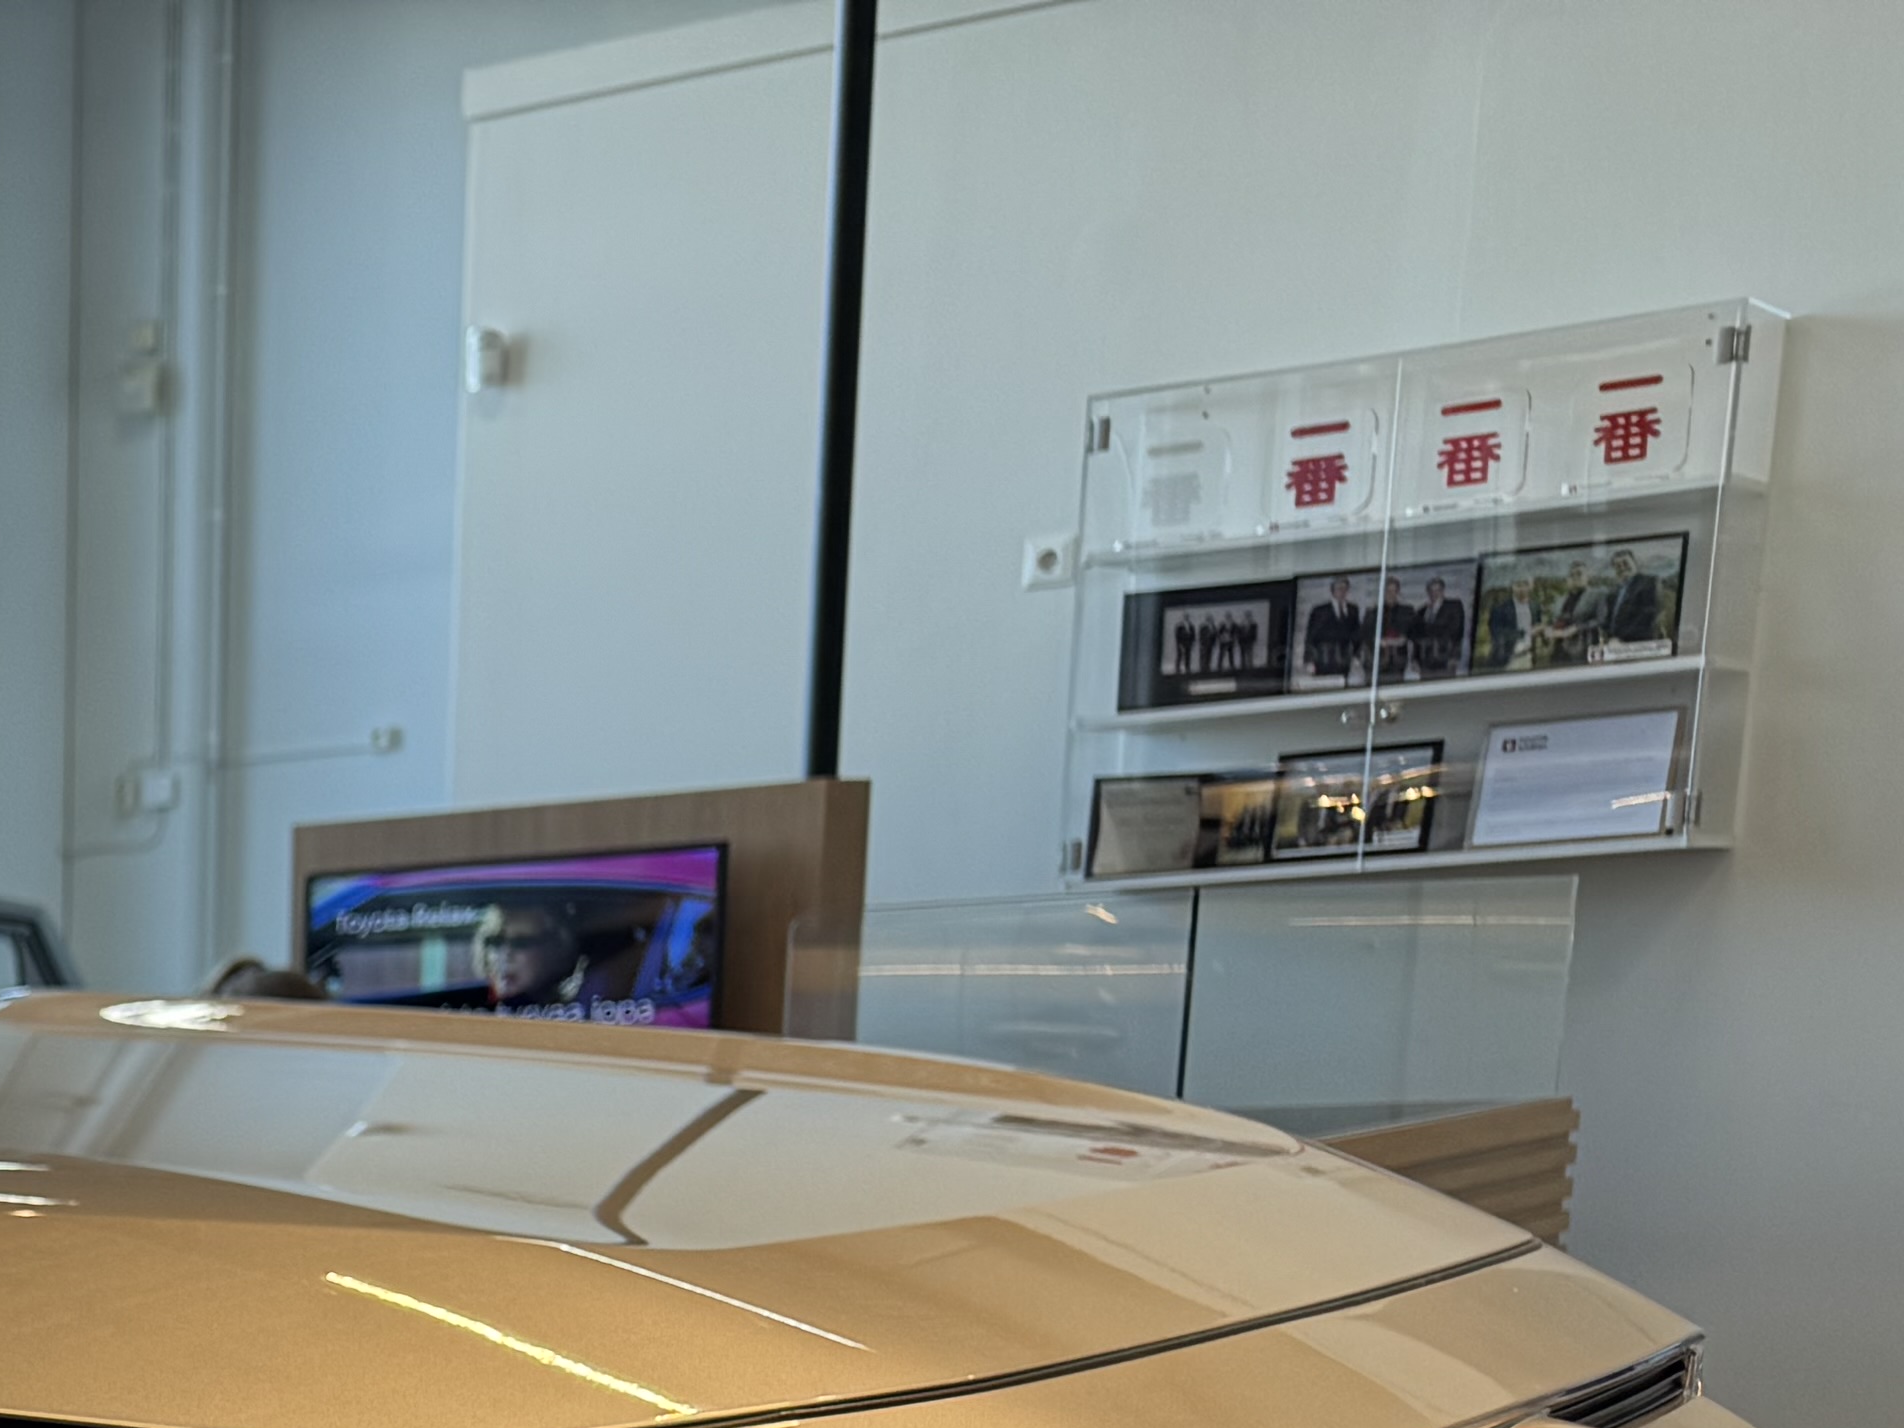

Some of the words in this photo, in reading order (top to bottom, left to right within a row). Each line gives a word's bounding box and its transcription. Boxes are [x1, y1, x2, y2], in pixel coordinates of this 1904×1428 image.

[1437, 398, 1502, 488] 一番
[1593, 374, 1663, 465] 一番
[1285, 420, 1350, 509] 一番
[336, 908, 410, 938] Toyota
